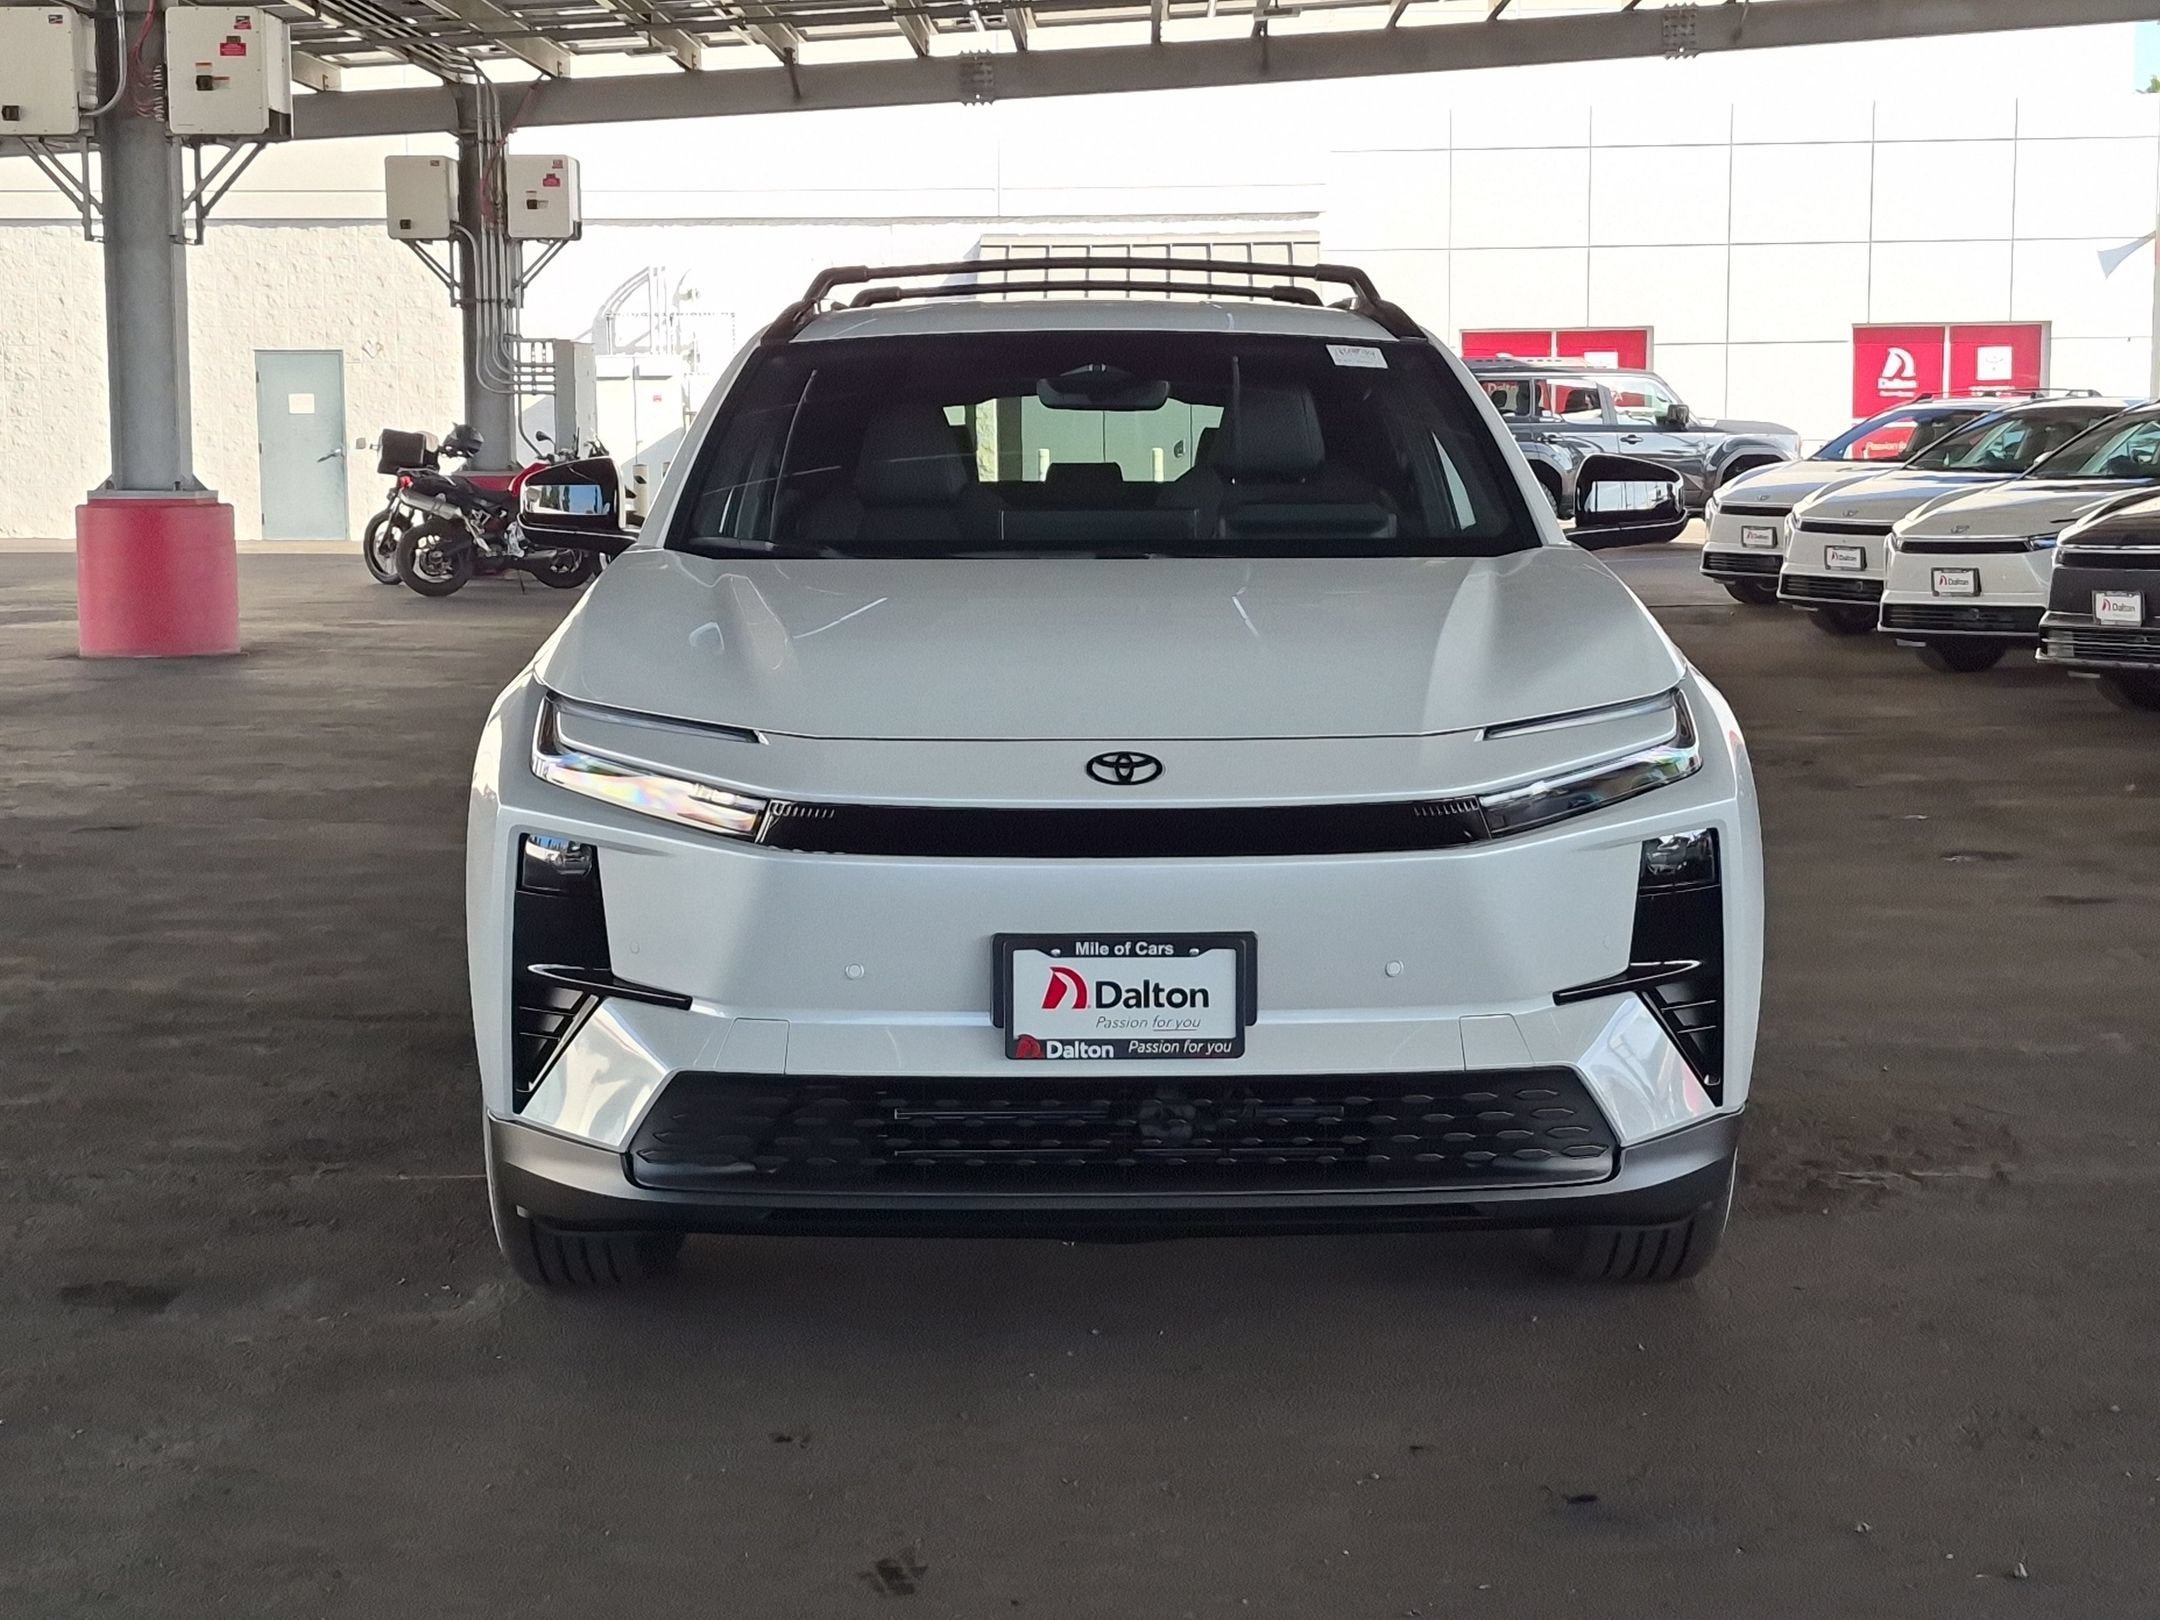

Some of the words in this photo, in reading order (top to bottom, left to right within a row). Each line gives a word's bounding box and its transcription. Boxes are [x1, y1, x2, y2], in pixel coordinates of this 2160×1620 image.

[1075, 941, 1109, 956] Mile
[1114, 941, 1131, 956] of
[1135, 941, 1175, 956] Cars
[1095, 979, 1209, 1009] Dalton
[1095, 1015, 1148, 1029] Passion
[1152, 1015, 1172, 1029] for
[1175, 1018, 1201, 1031] you
[1046, 1040, 1115, 1059] Dalton
[1128, 1039, 1180, 1054] Passion
[1183, 1039, 1204, 1054] for
[1205, 1041, 1232, 1056] you
